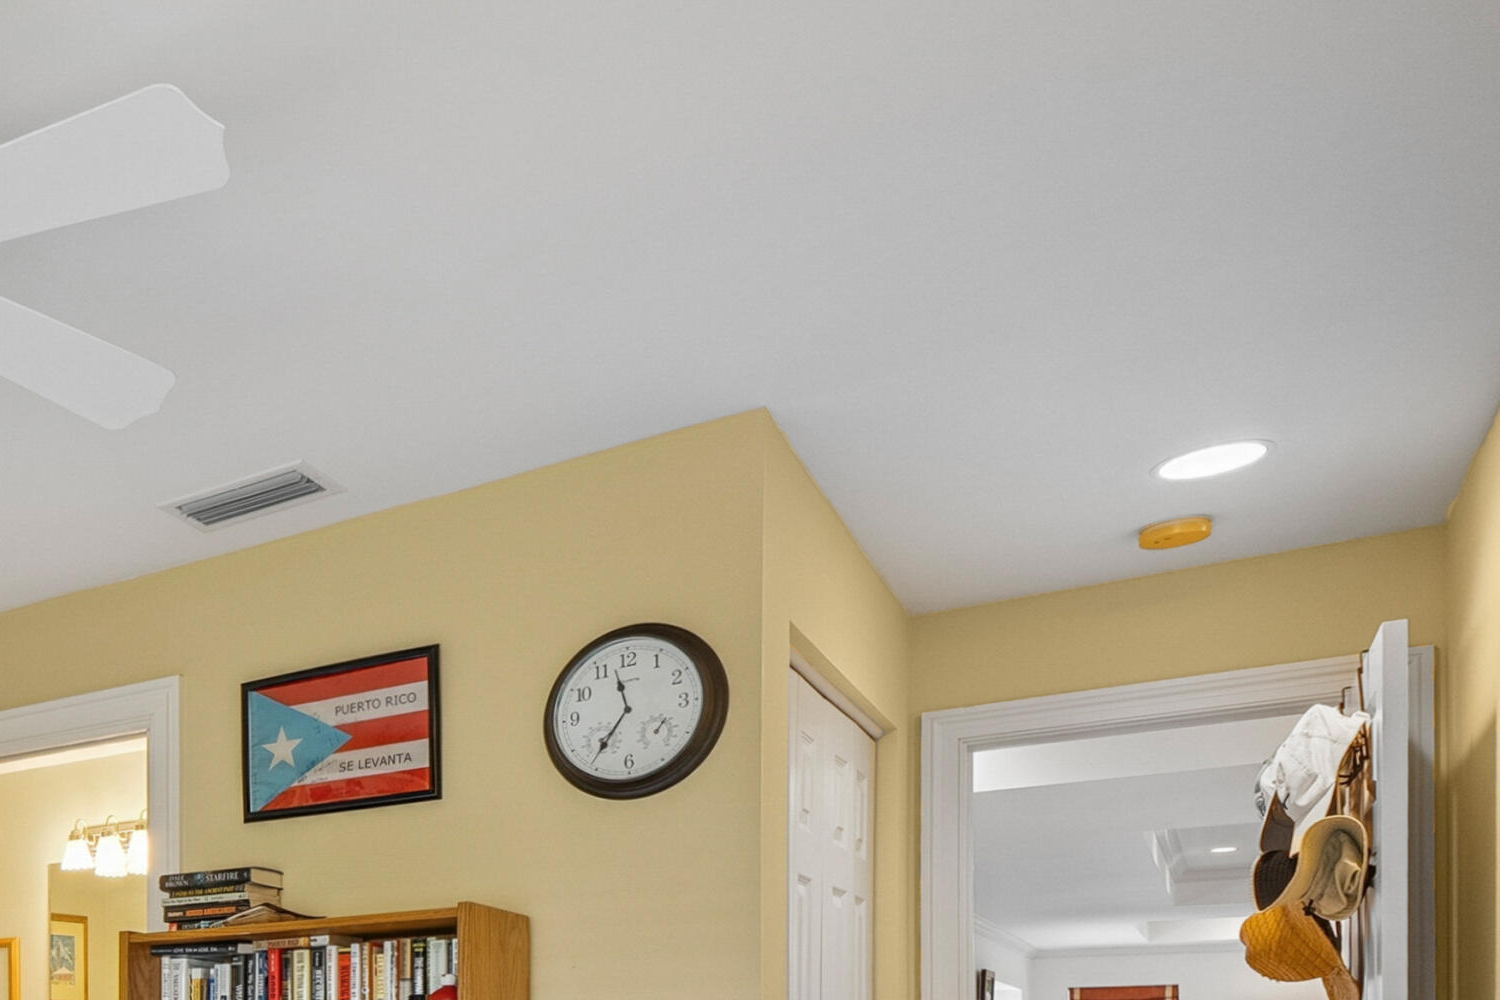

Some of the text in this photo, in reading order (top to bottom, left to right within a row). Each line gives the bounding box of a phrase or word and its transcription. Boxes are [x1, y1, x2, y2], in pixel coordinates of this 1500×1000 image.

[619, 651, 637, 669] 12
[653, 654, 661, 669] 1
[594, 664, 609, 680] 11
[671, 669, 683, 685] 2
[576, 686, 592, 703] 10
[678, 692, 690, 708] 3
[334, 692, 418, 716] PUERTO RICO
[570, 712, 580, 726] 9
[339, 752, 412, 773] SE LEVANTA
[624, 753, 635, 770] 6
[205, 871, 239, 882] STARFIRE
